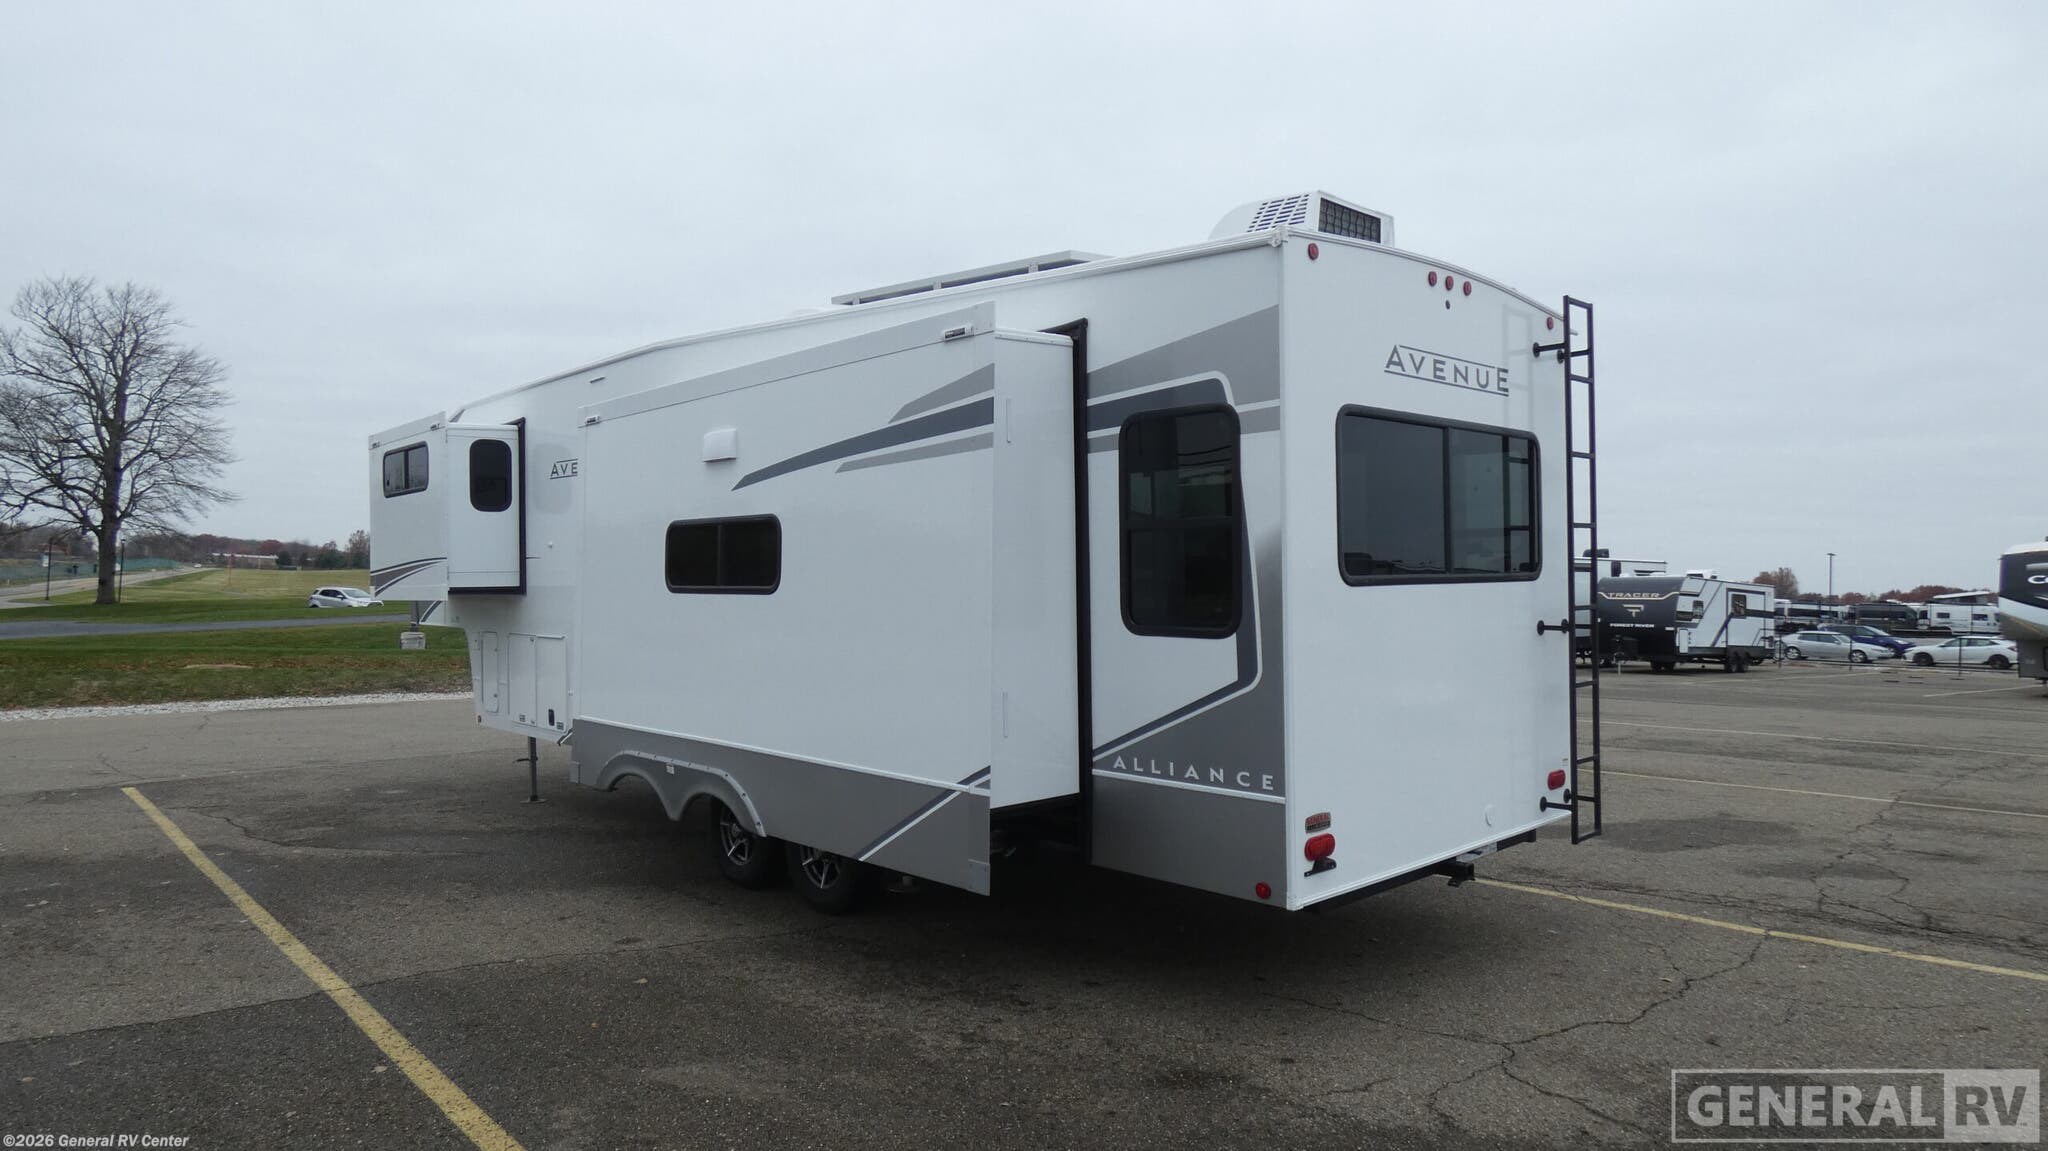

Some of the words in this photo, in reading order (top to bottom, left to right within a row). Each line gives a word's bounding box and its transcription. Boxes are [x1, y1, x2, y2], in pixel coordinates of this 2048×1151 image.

[1385, 344, 1509, 393] AVENUE
[550, 462, 578, 477] AVE
[1113, 755, 1274, 790] ALLIANCE
